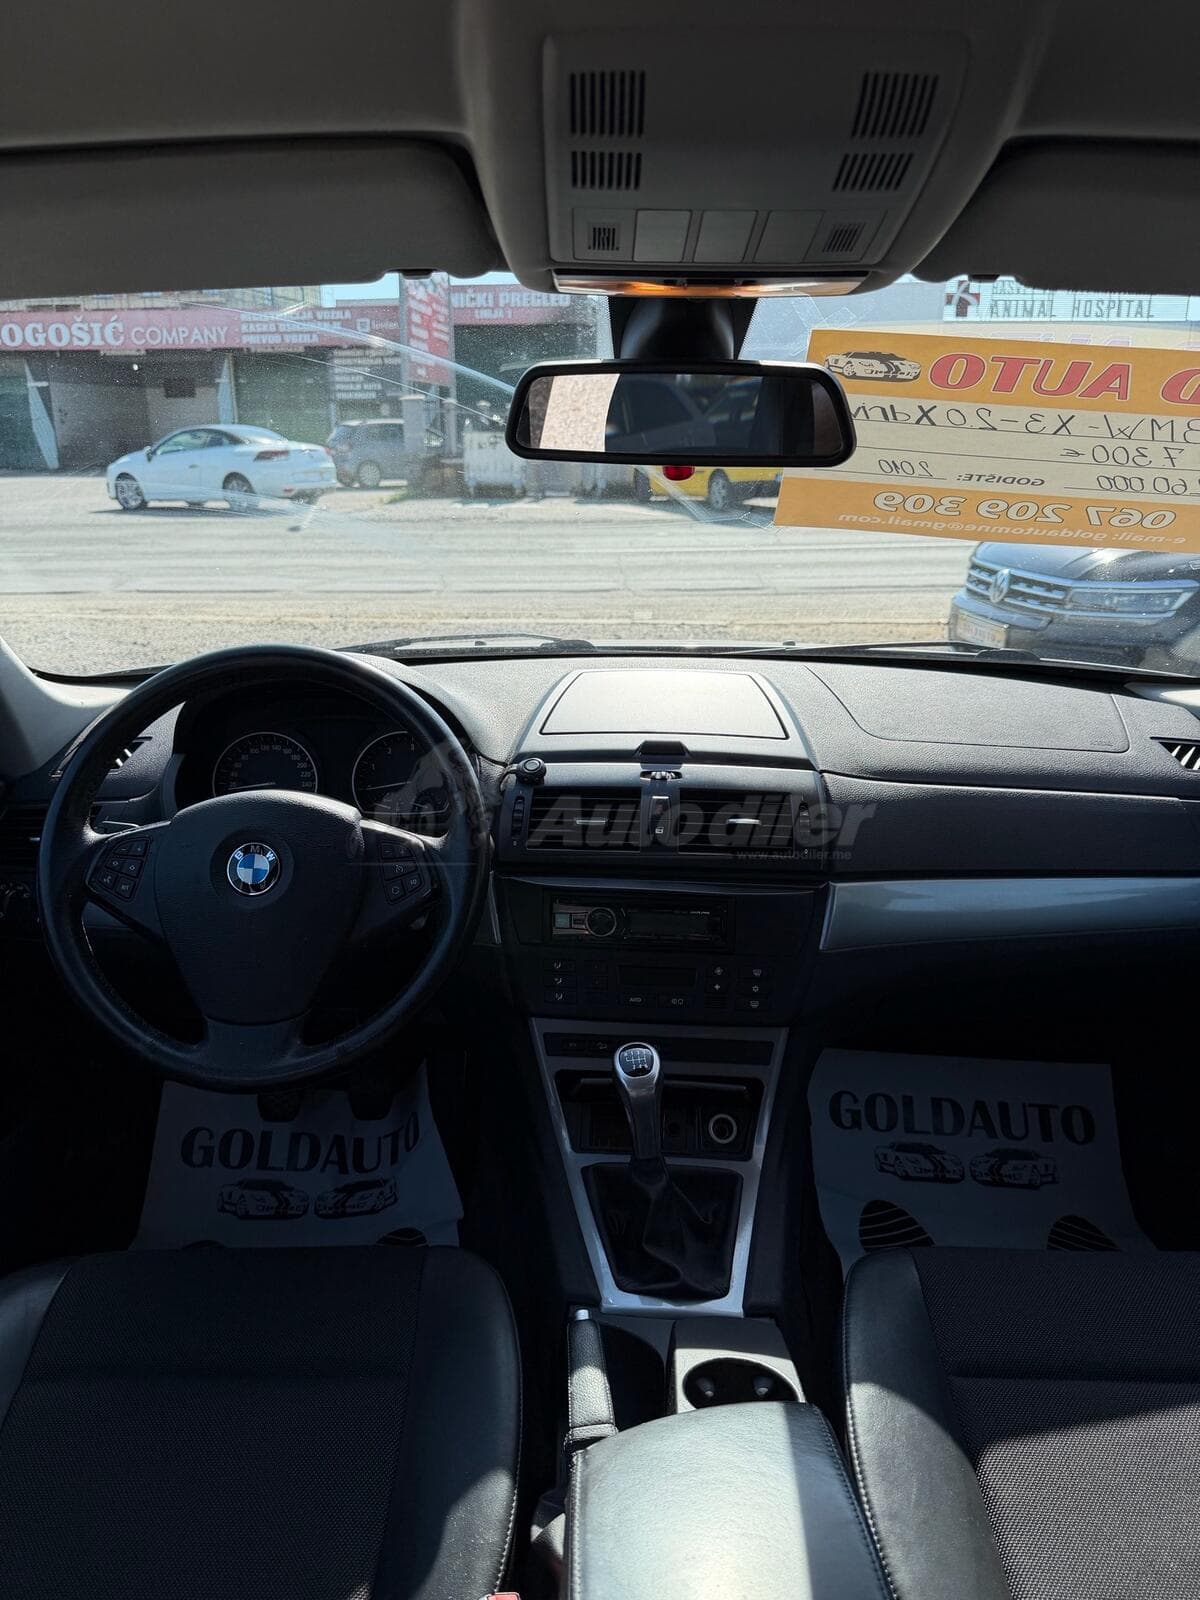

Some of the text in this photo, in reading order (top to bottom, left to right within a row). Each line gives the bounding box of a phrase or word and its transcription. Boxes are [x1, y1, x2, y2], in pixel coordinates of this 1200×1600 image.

[990, 299, 1155, 318] ANIMAL HOSPITAL
[0, 314, 125, 348] OGOŠIĆ
[131, 326, 229, 345] COMPANY
[234, 845, 276, 861] BMW
[829, 1090, 1097, 1146] GOLDAUTO
[180, 1111, 420, 1175] GOLDAUTO
